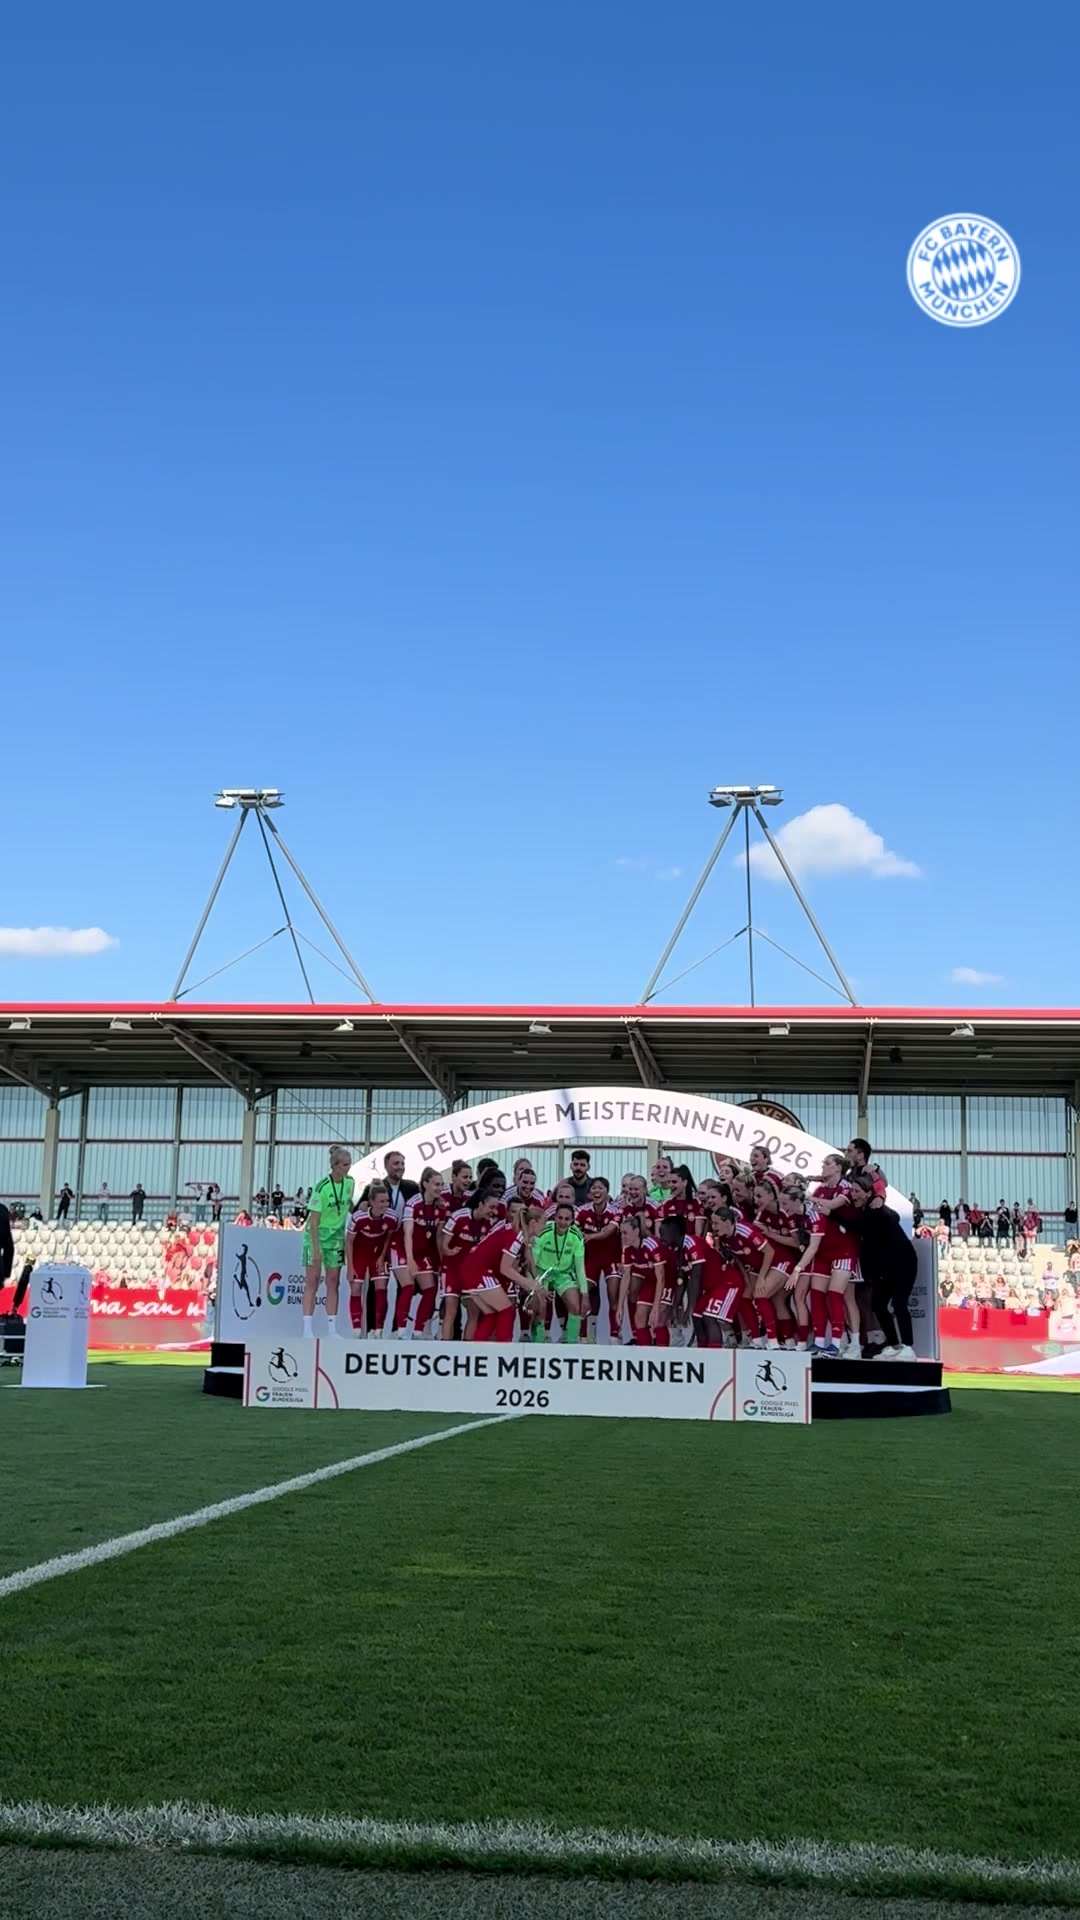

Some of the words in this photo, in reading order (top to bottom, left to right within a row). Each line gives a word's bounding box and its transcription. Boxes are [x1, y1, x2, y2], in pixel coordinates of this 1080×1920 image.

[417, 1106, 547, 1161] DEUTSCHE
[555, 1101, 744, 1141] MEISTERINNEN
[749, 1129, 813, 1170] 2026
[128, 1299, 183, 1317] san
[705, 1298, 723, 1315] 15
[345, 1353, 489, 1377] DEUTSCHE
[498, 1356, 704, 1384] MEISTERINNEN
[496, 1389, 550, 1408] 2026
